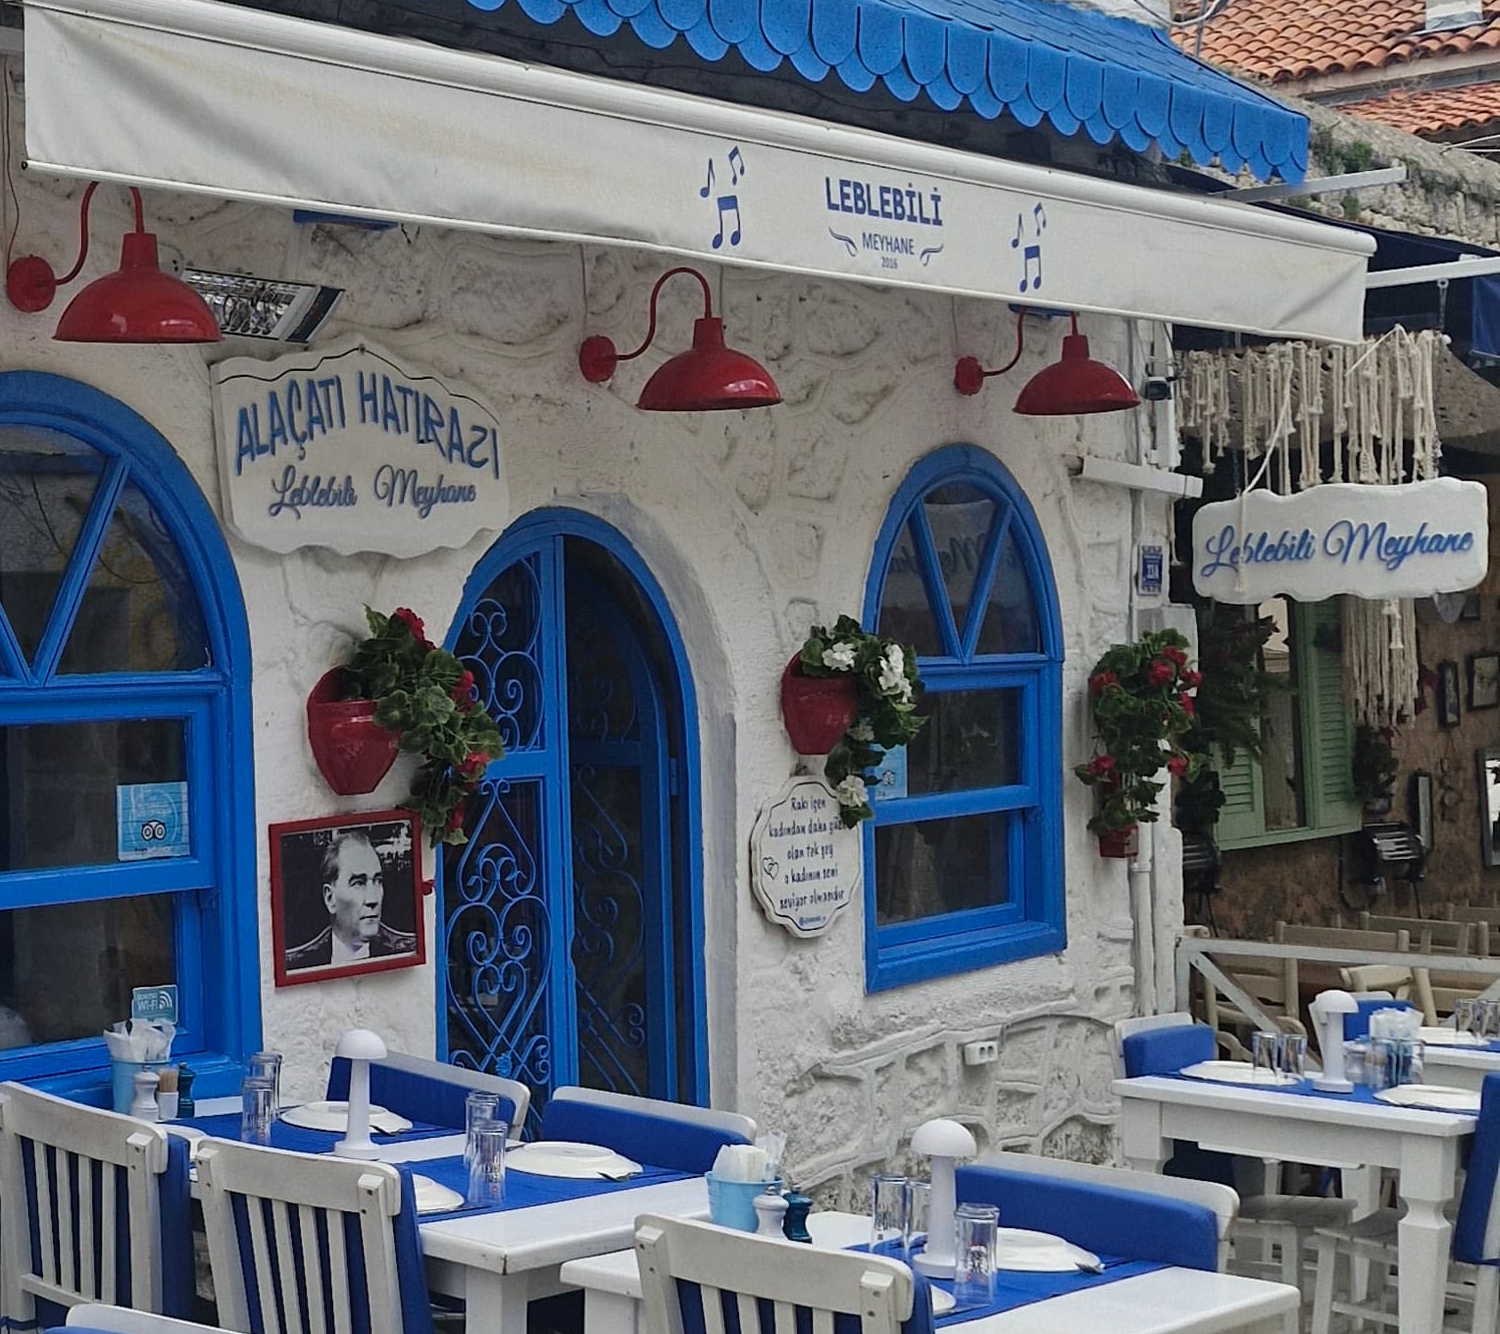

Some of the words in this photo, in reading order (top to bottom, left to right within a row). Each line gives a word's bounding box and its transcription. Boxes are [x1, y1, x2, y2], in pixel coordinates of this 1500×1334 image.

[825, 176, 943, 227] LEBLEBİLİ
[862, 231, 915, 256] MEYHANE
[235, 374, 345, 476] ALAÇATI
[268, 464, 358, 520] Leblebili
[373, 464, 477, 518] Meyhane
[1200, 525, 1316, 577] Leblebili
[1323, 520, 1474, 571] Meyhane
